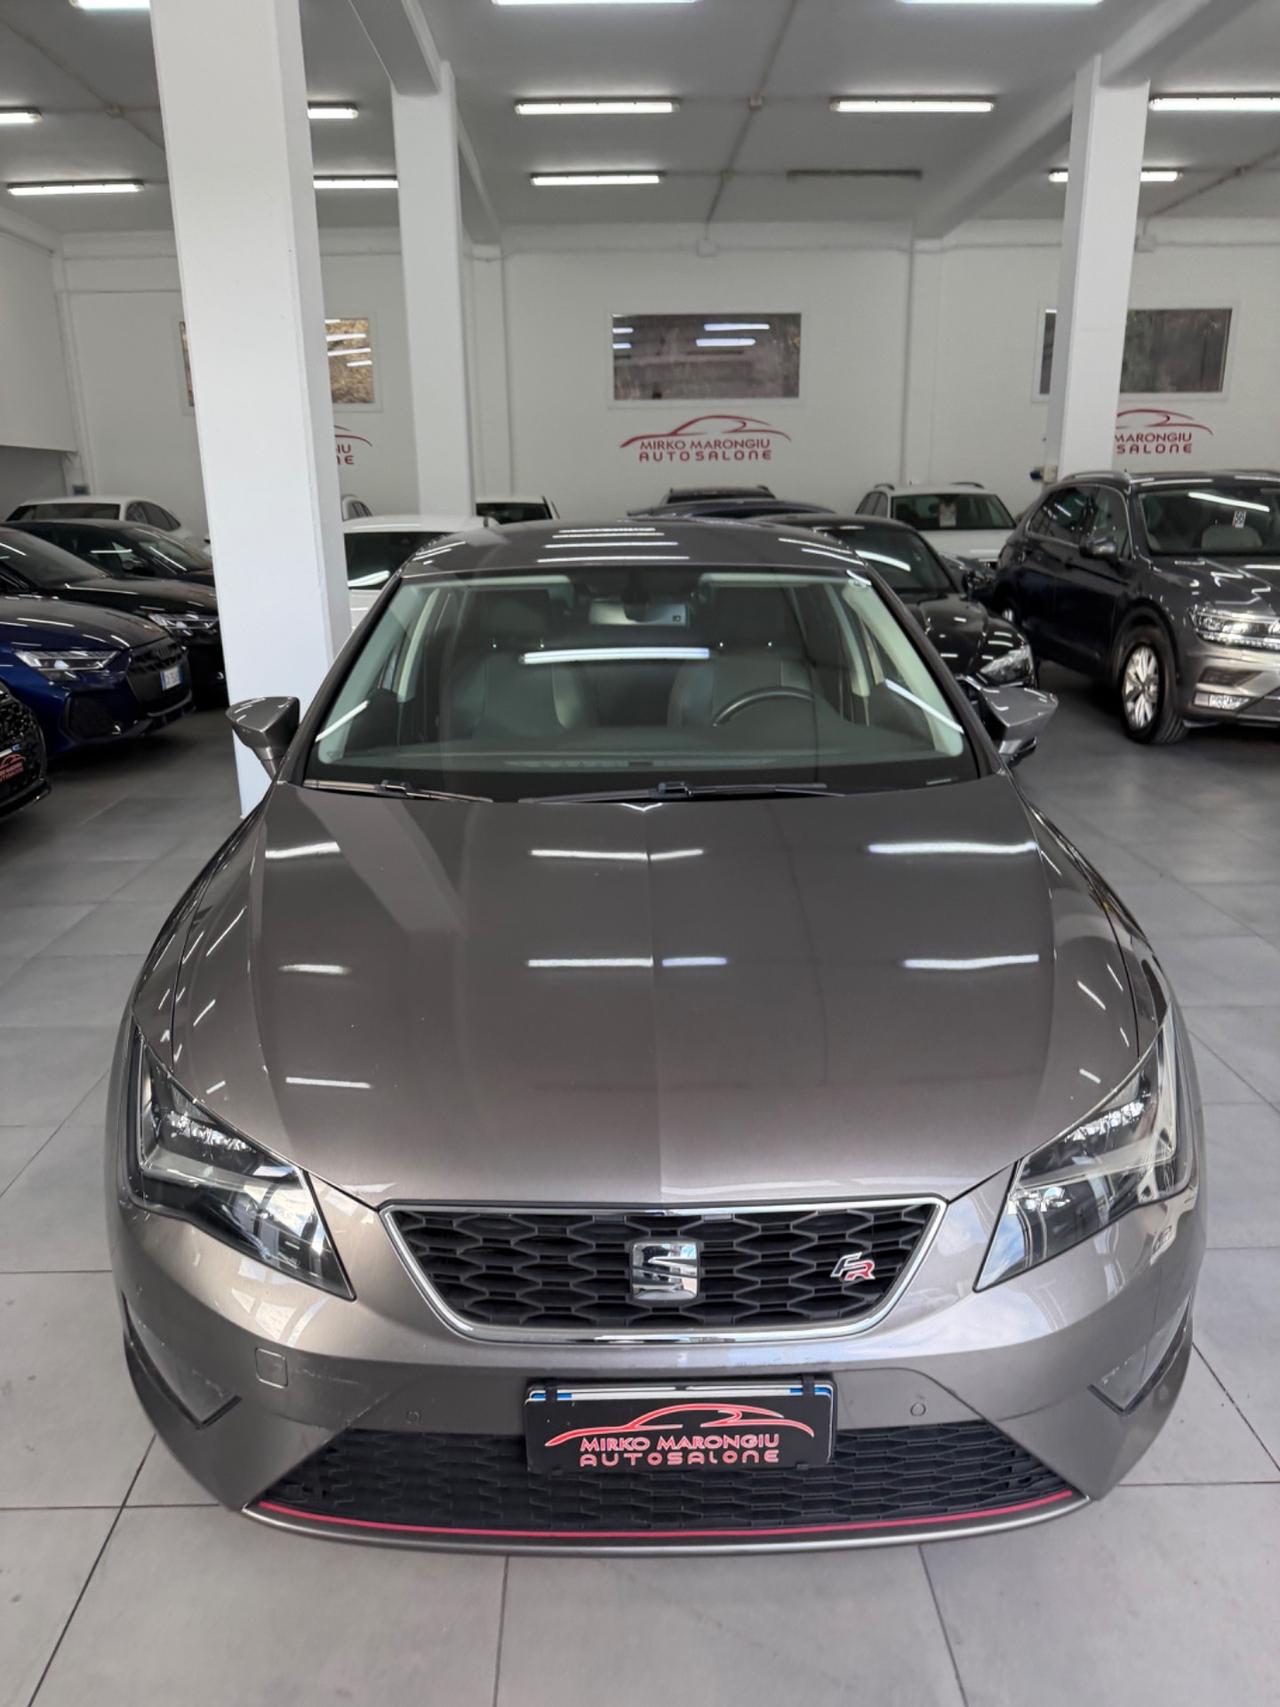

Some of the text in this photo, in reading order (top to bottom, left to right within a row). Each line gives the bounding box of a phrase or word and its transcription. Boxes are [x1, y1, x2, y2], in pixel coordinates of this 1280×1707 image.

[640, 439, 770, 450] MIRKO MARONGIU
[1116, 443, 1192, 454] SALONE
[639, 450, 772, 461] AUTOSALONE
[830, 1251, 876, 1281] FR
[580, 1433, 780, 1451] MIRKO MARONGIU
[579, 1450, 780, 1467] AUTOSALONE
